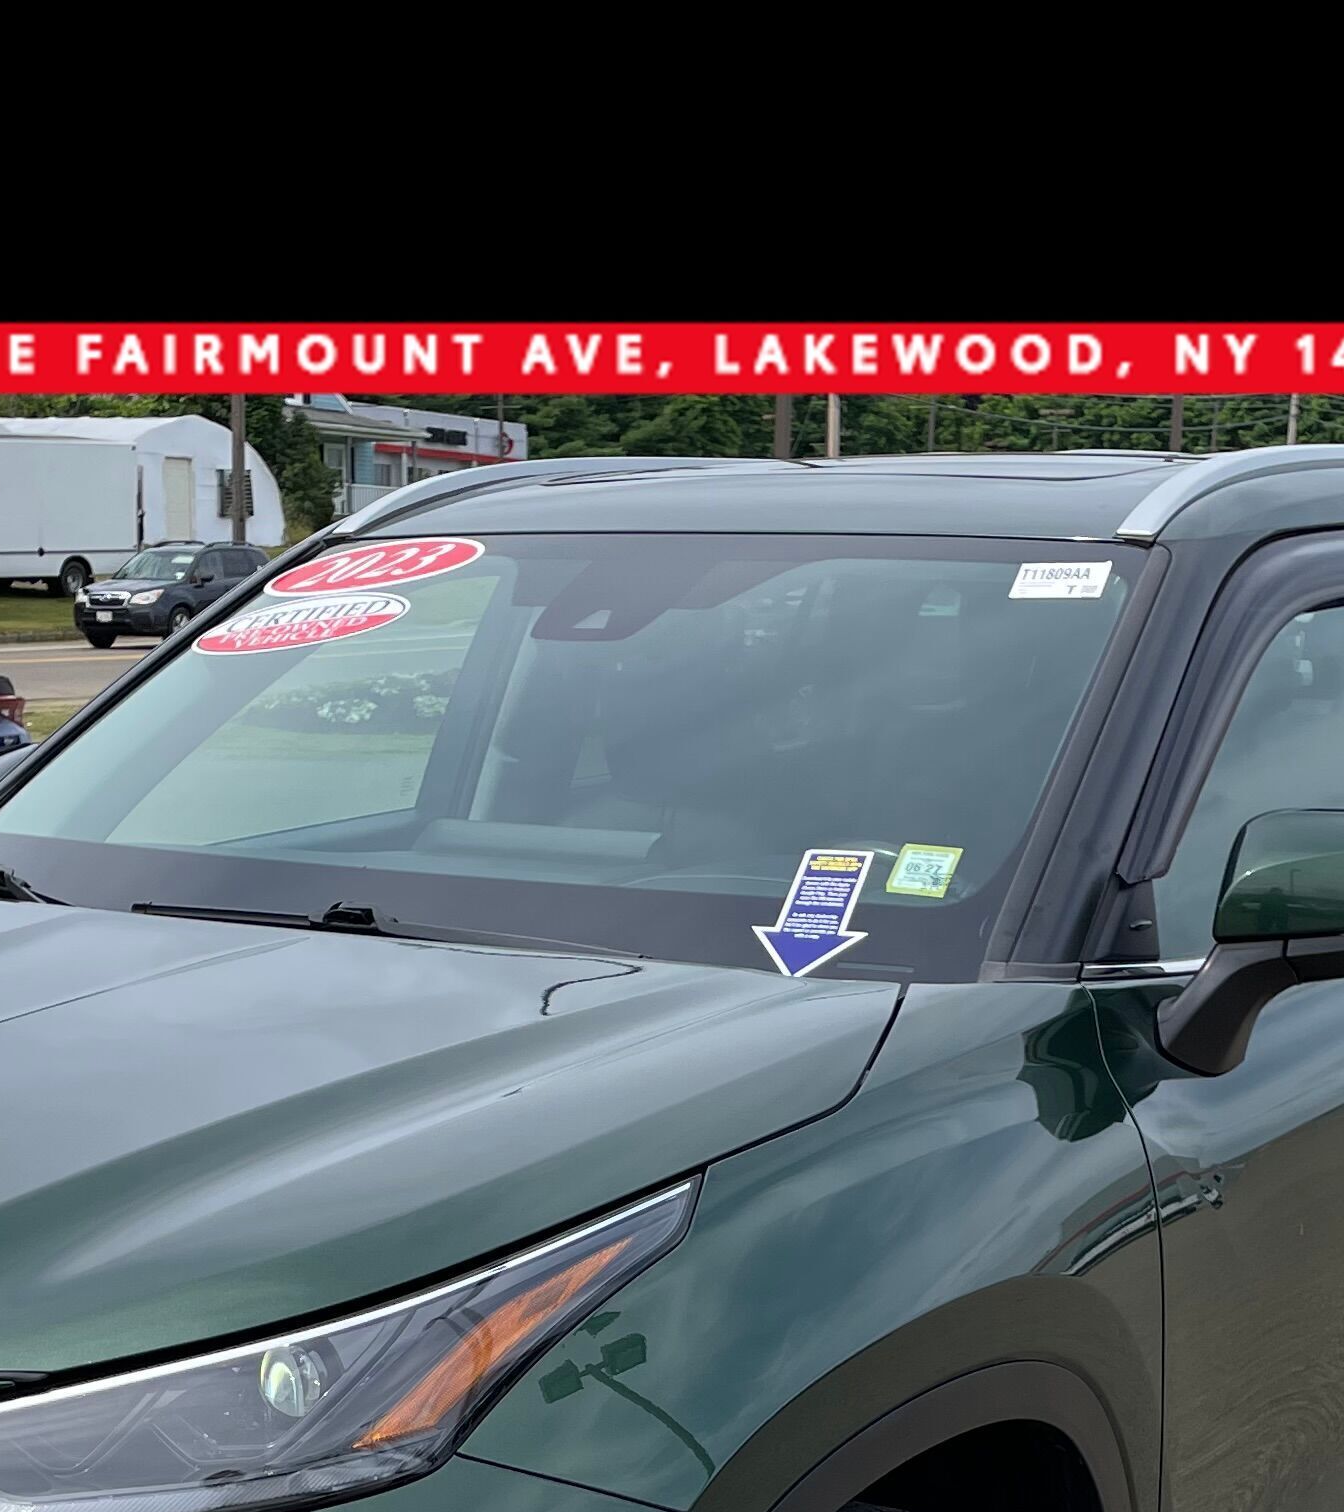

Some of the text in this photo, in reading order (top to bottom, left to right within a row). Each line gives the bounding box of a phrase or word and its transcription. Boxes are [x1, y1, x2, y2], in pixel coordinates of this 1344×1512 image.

[287, 542, 457, 591] 2023
[220, 616, 369, 645] PRE-OWNED
[228, 600, 390, 633] CERTIFIED
[236, 629, 340, 649] VEHICLE
